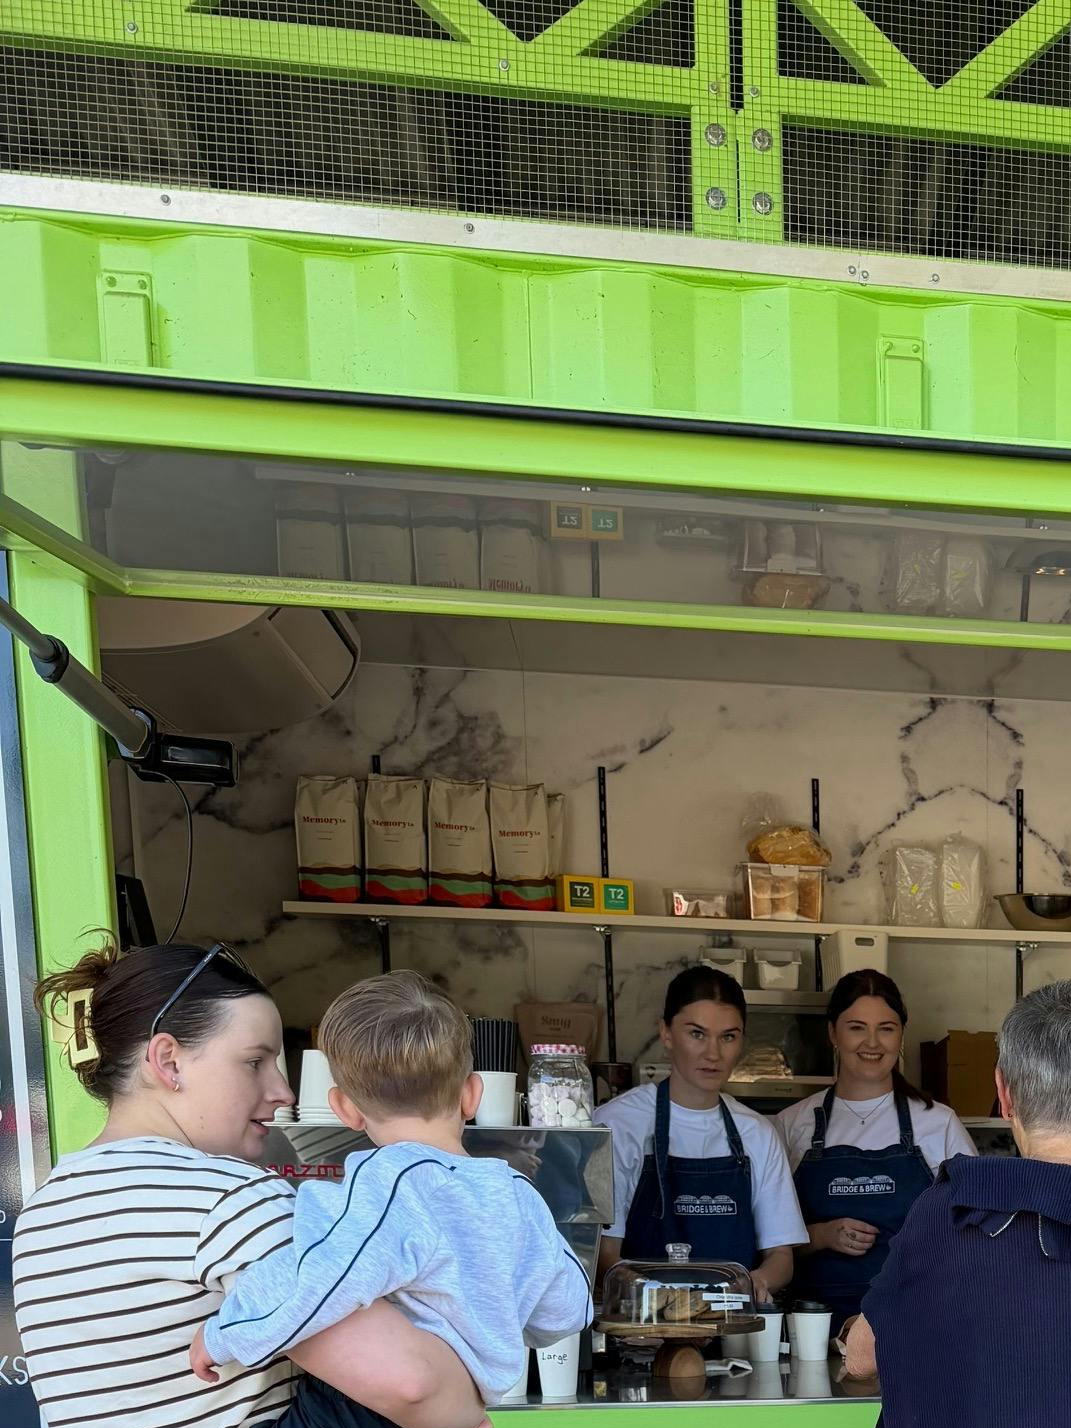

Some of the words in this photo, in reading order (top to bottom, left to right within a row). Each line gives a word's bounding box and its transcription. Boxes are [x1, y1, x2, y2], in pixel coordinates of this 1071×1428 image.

[303, 816, 339, 825] Memory
[371, 820, 407, 828] Memory
[434, 822, 468, 832] Memory
[498, 830, 533, 838] Memory
[574, 885, 590, 897] T2
[608, 888, 624, 900] T2
[832, 1185, 859, 1194] BRIDGE
[865, 1184, 886, 1193] BREW
[676, 1204, 704, 1213] BRIDGE
[709, 1204, 727, 1213] BREW
[541, 1351, 568, 1365] Large
